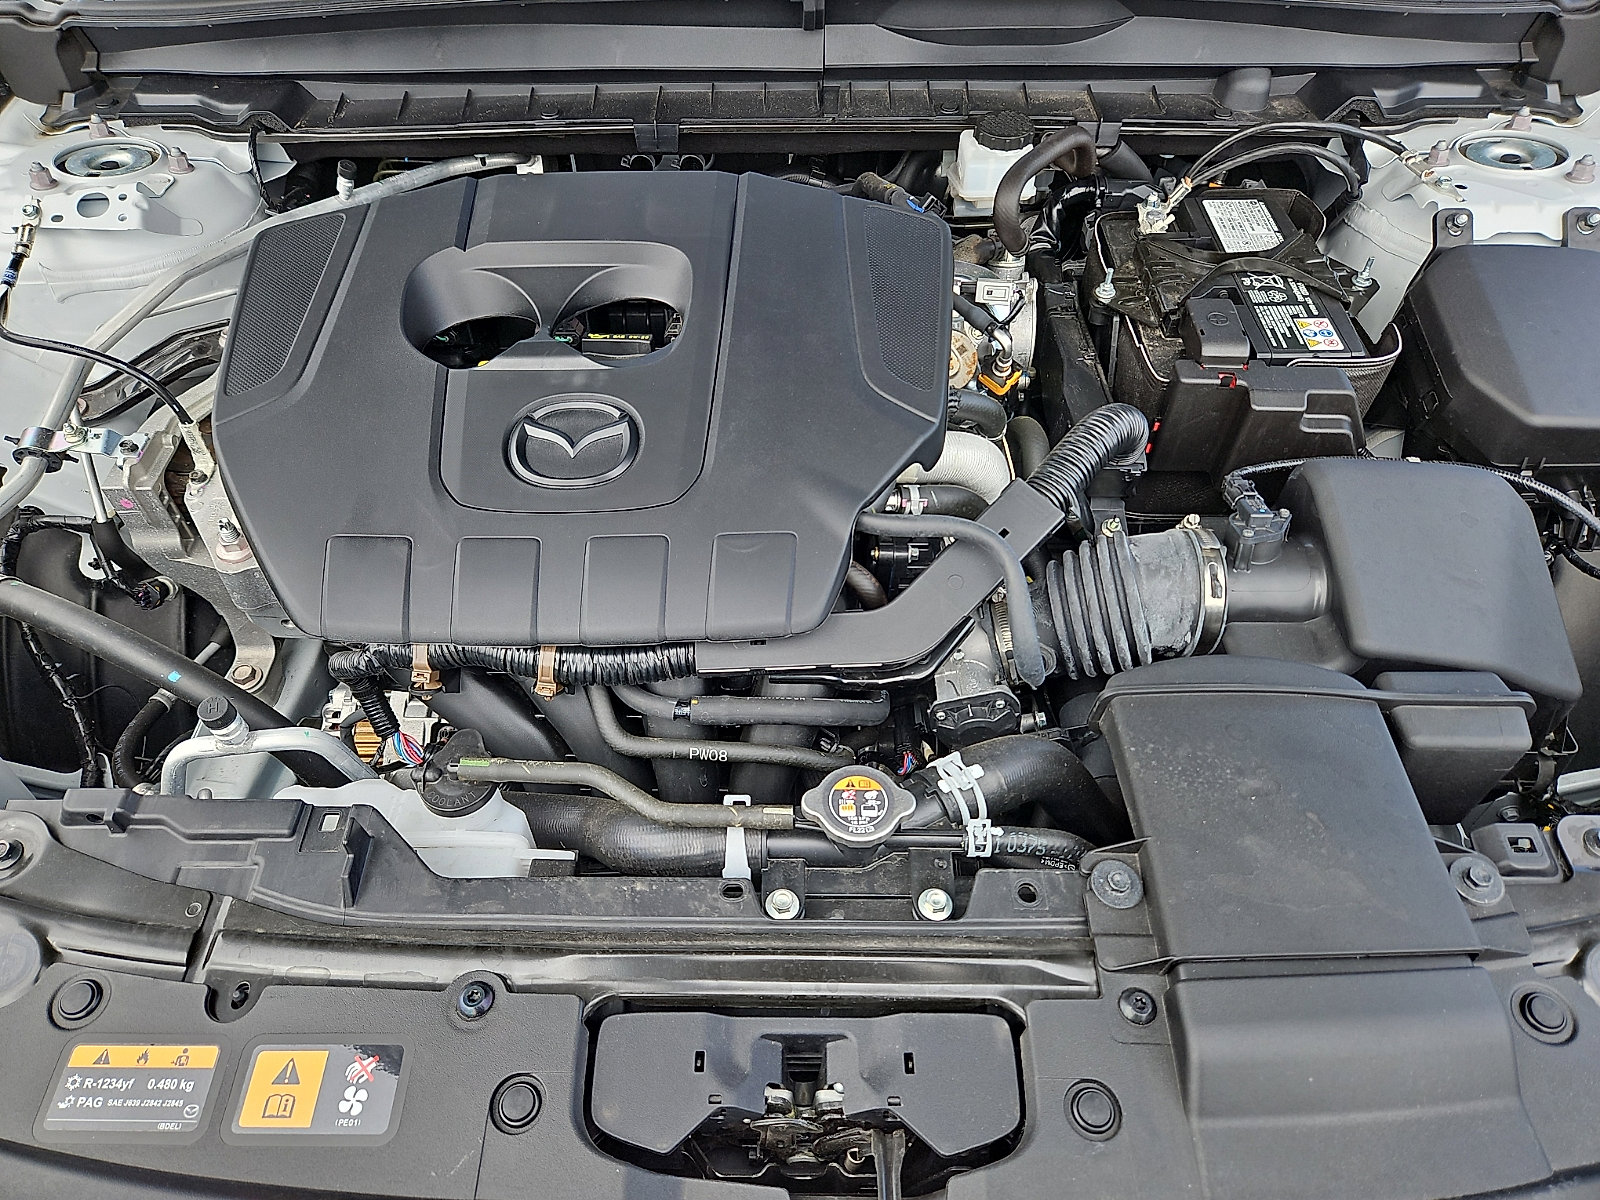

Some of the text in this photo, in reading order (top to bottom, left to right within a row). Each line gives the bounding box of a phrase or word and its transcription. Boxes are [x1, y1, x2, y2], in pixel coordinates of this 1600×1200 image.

[207, 701, 219, 714] H
[689, 747, 728, 762] PW08
[426, 790, 477, 807] COOLANT
[82, 1077, 195, 1093] R-1234yf 0.480 kg
[76, 1096, 104, 1108] PAG
[107, 1099, 124, 1107] SAE
